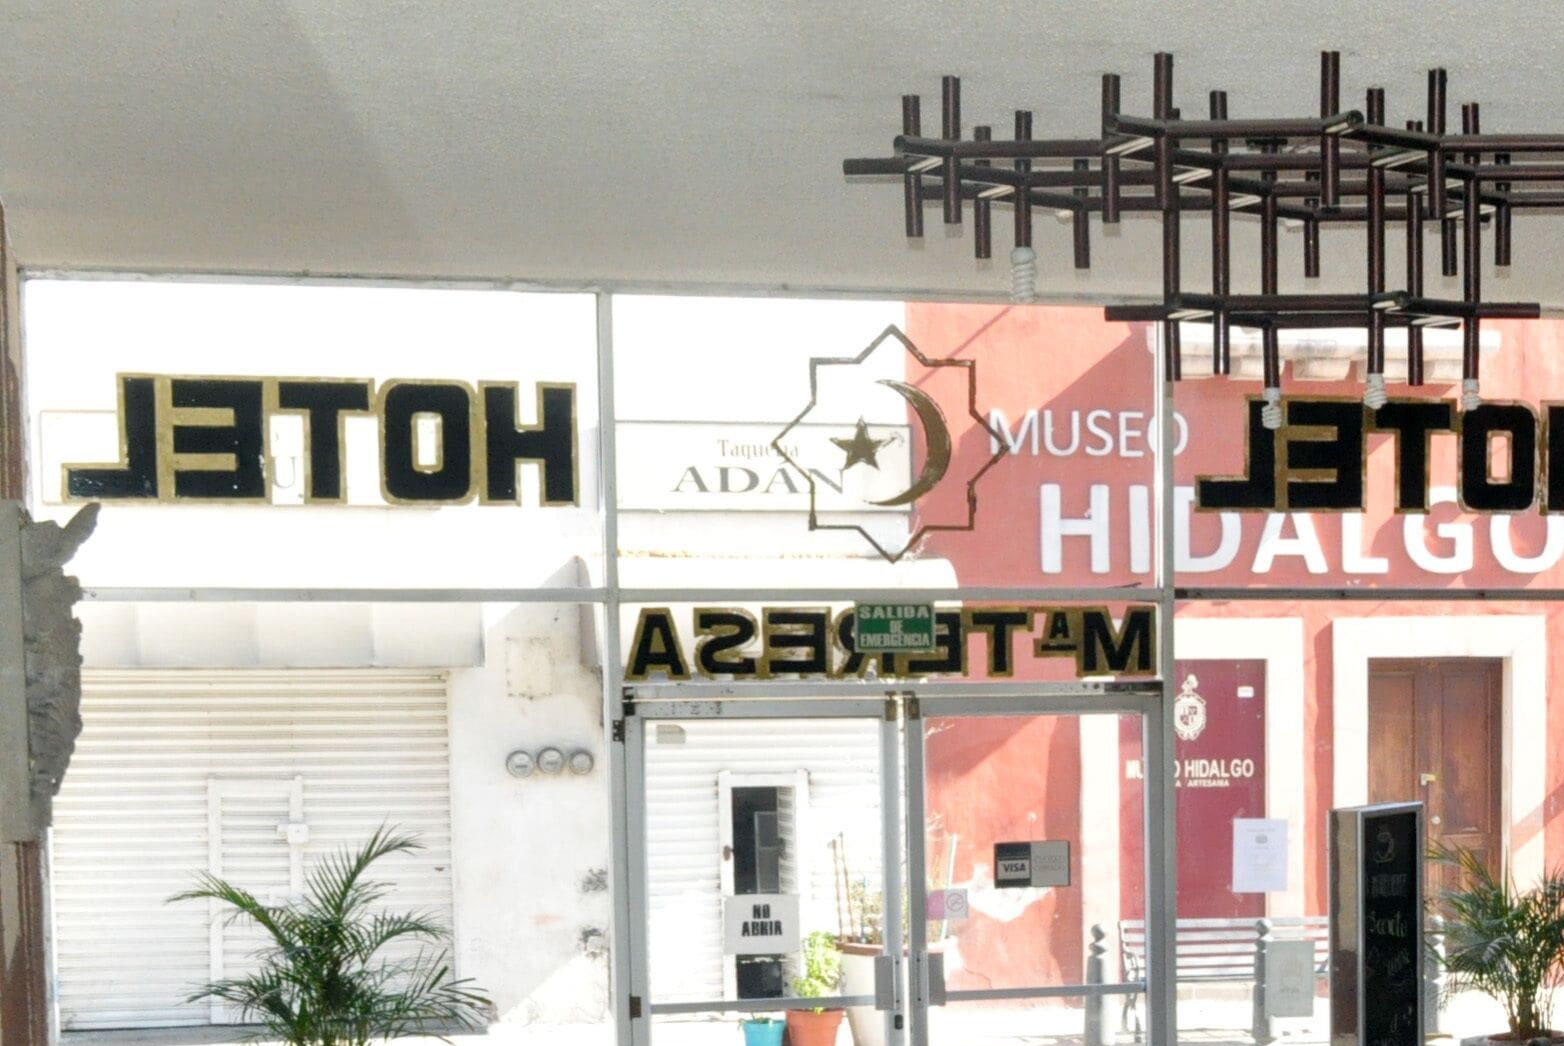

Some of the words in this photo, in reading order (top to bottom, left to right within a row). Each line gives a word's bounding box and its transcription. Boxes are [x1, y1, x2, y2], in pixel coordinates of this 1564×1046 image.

[988, 408, 1188, 459] MUSEO
[859, 606, 930, 619] SALIDA
[889, 620, 904, 633] DE
[860, 633, 930, 647] EMERGENCIA
[1125, 758, 1181, 779] MUO
[1184, 758, 1255, 779] HIDALGO
[1003, 862, 1026, 873] VISA
[752, 903, 771, 920] NO
[741, 920, 783, 937] ABRIR
